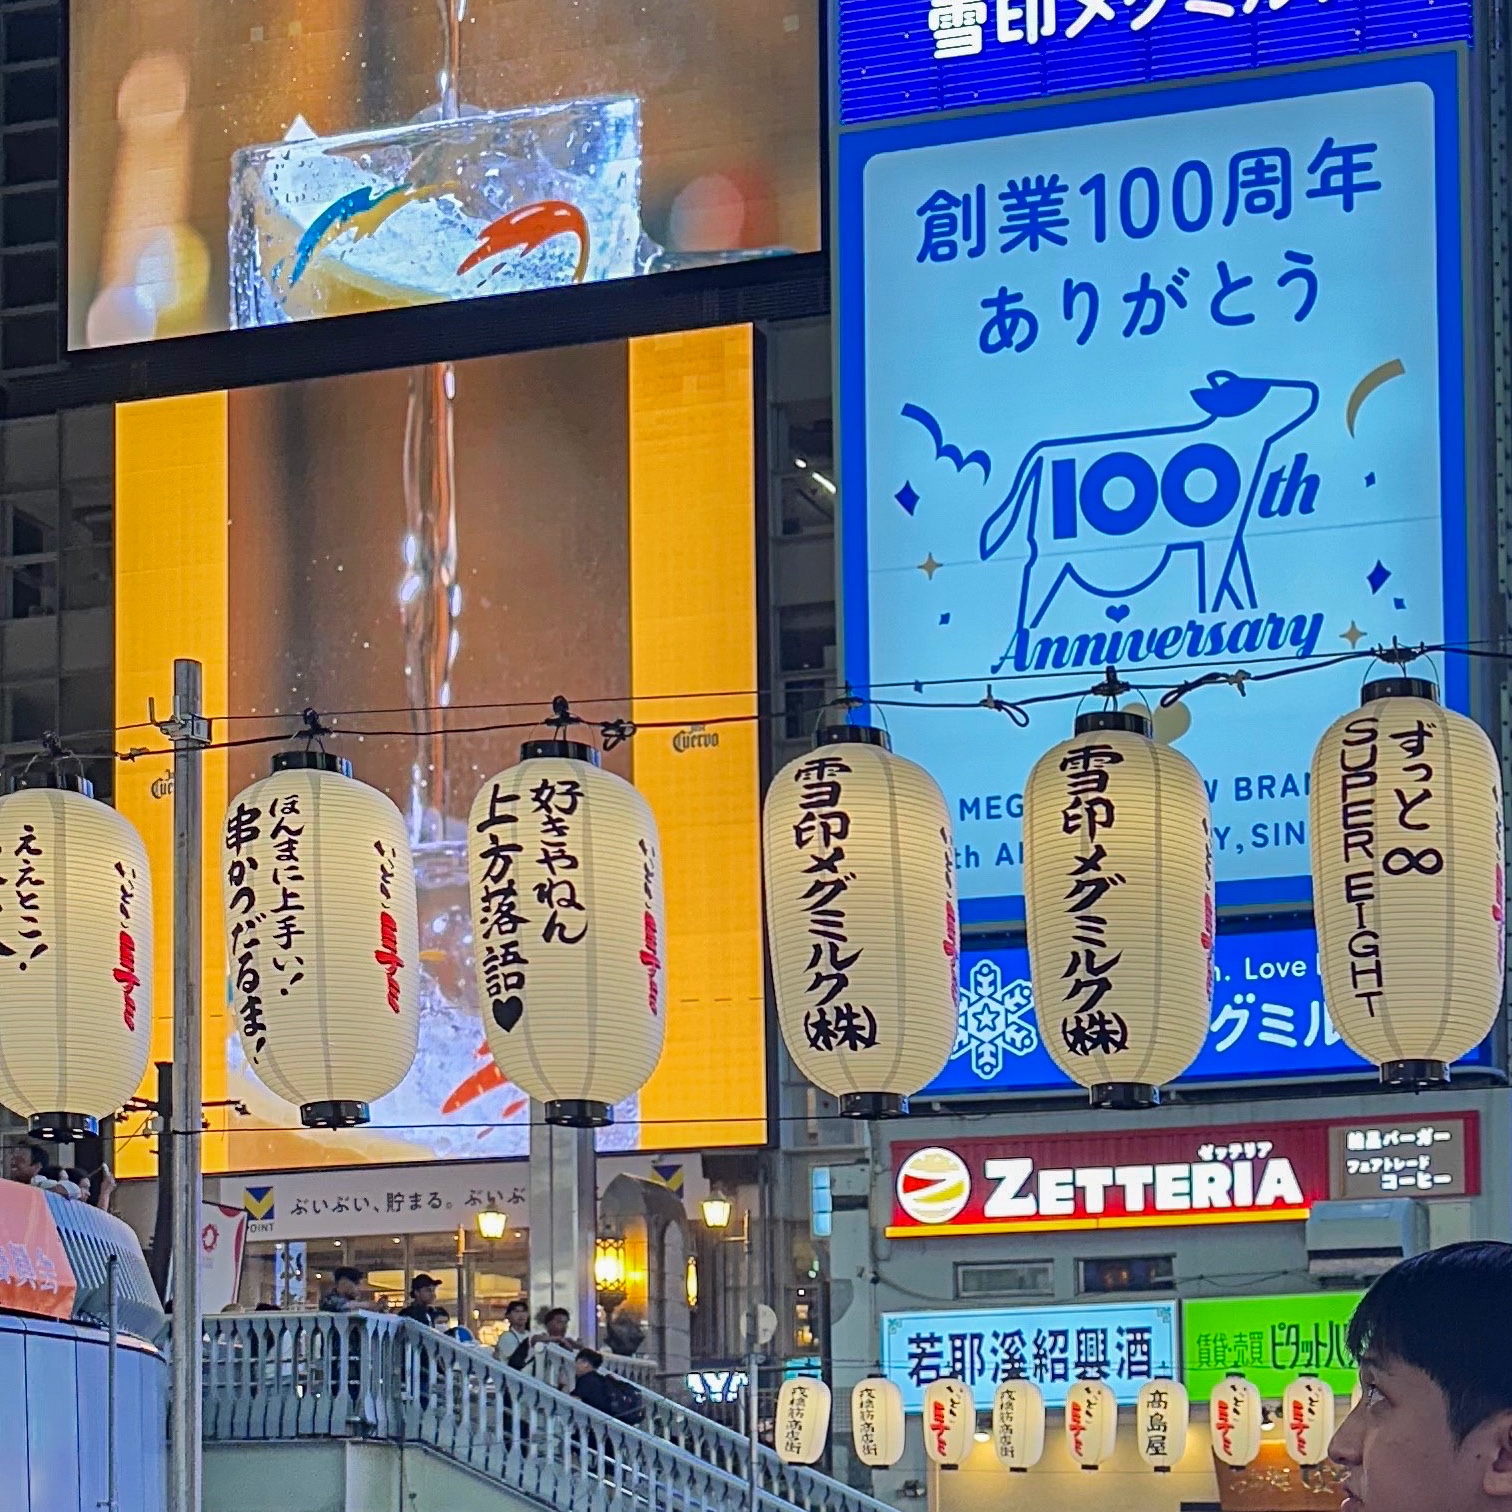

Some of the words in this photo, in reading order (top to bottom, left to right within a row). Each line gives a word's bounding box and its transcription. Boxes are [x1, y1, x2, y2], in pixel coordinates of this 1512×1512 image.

[917, 137, 1383, 263] 創業100周年
[978, 250, 1320, 354] ありがとう
[991, 609, 1325, 675] Anniversary
[1340, 718, 1379, 864] SUPER
[530, 778, 589, 944] 好きやねん
[1245, 957, 1307, 980] Love
[1344, 871, 1384, 1018] EIGHT
[246, 1222, 275, 1234] OINT
[983, 1157, 1304, 1218] ZETTERIA
